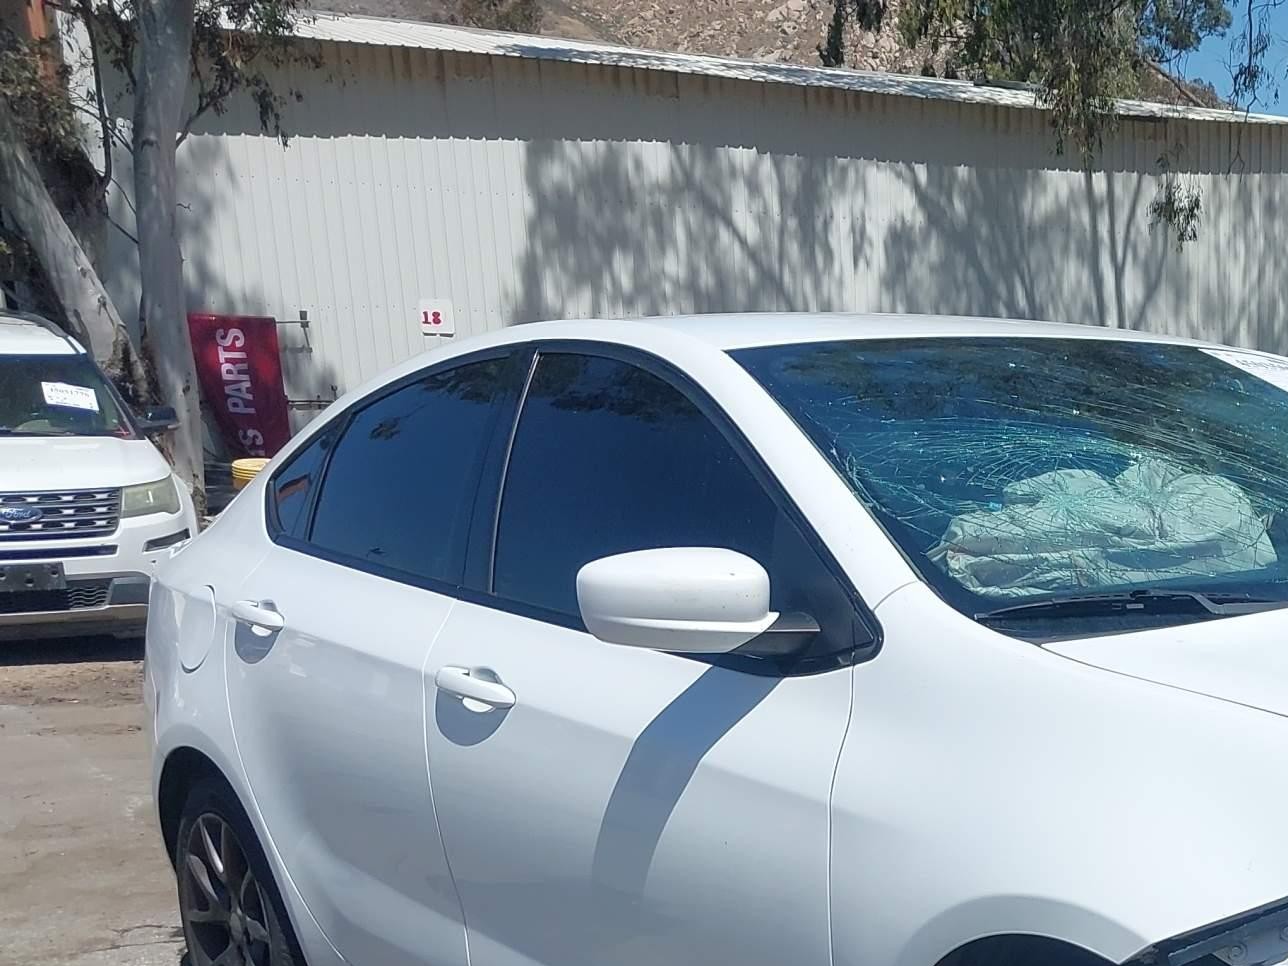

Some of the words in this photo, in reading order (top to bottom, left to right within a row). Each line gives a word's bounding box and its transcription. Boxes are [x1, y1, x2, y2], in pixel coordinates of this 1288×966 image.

[422, 310, 442, 325] 18
[216, 328, 257, 415] PARTS
[2, 508, 32, 519] Ford
